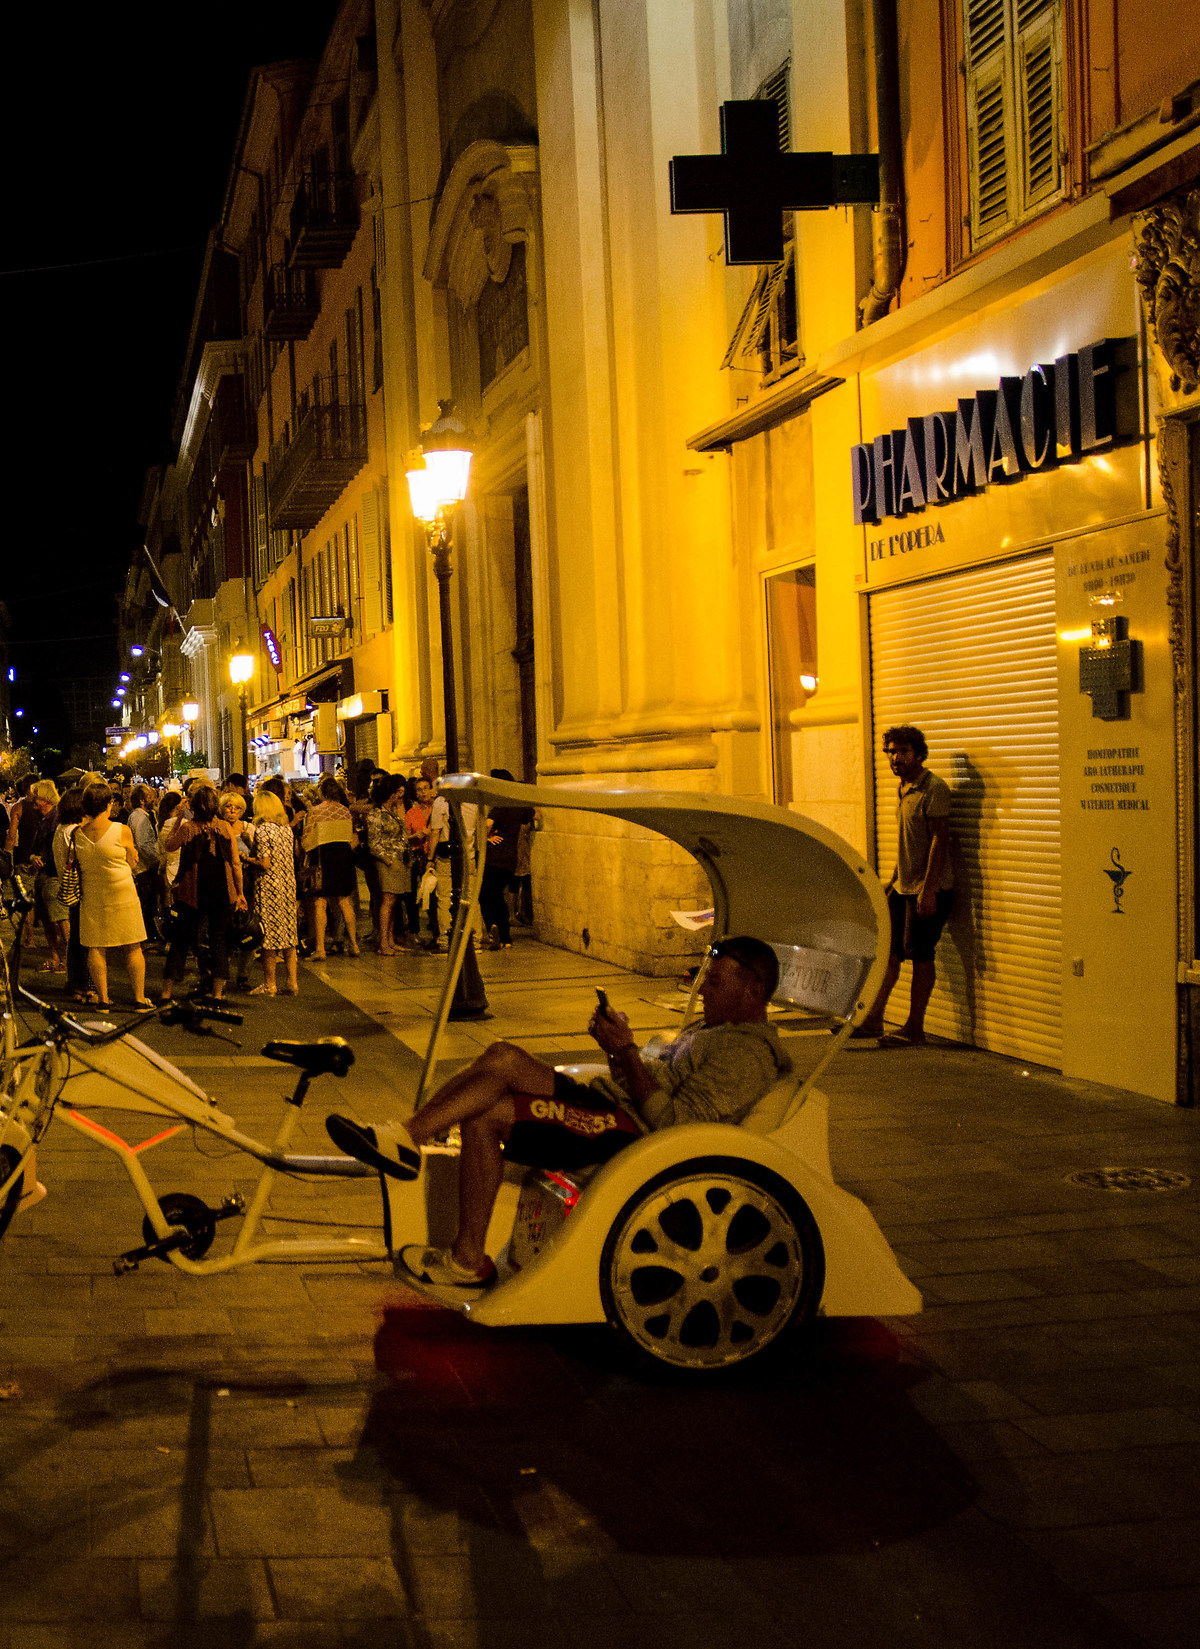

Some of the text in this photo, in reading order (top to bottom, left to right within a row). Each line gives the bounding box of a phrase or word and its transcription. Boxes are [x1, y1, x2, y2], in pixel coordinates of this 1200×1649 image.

[850, 338, 1130, 525] PHARMACIE
[871, 521, 946, 561] DE L'OPERA
[263, 630, 281, 665] TABAC
